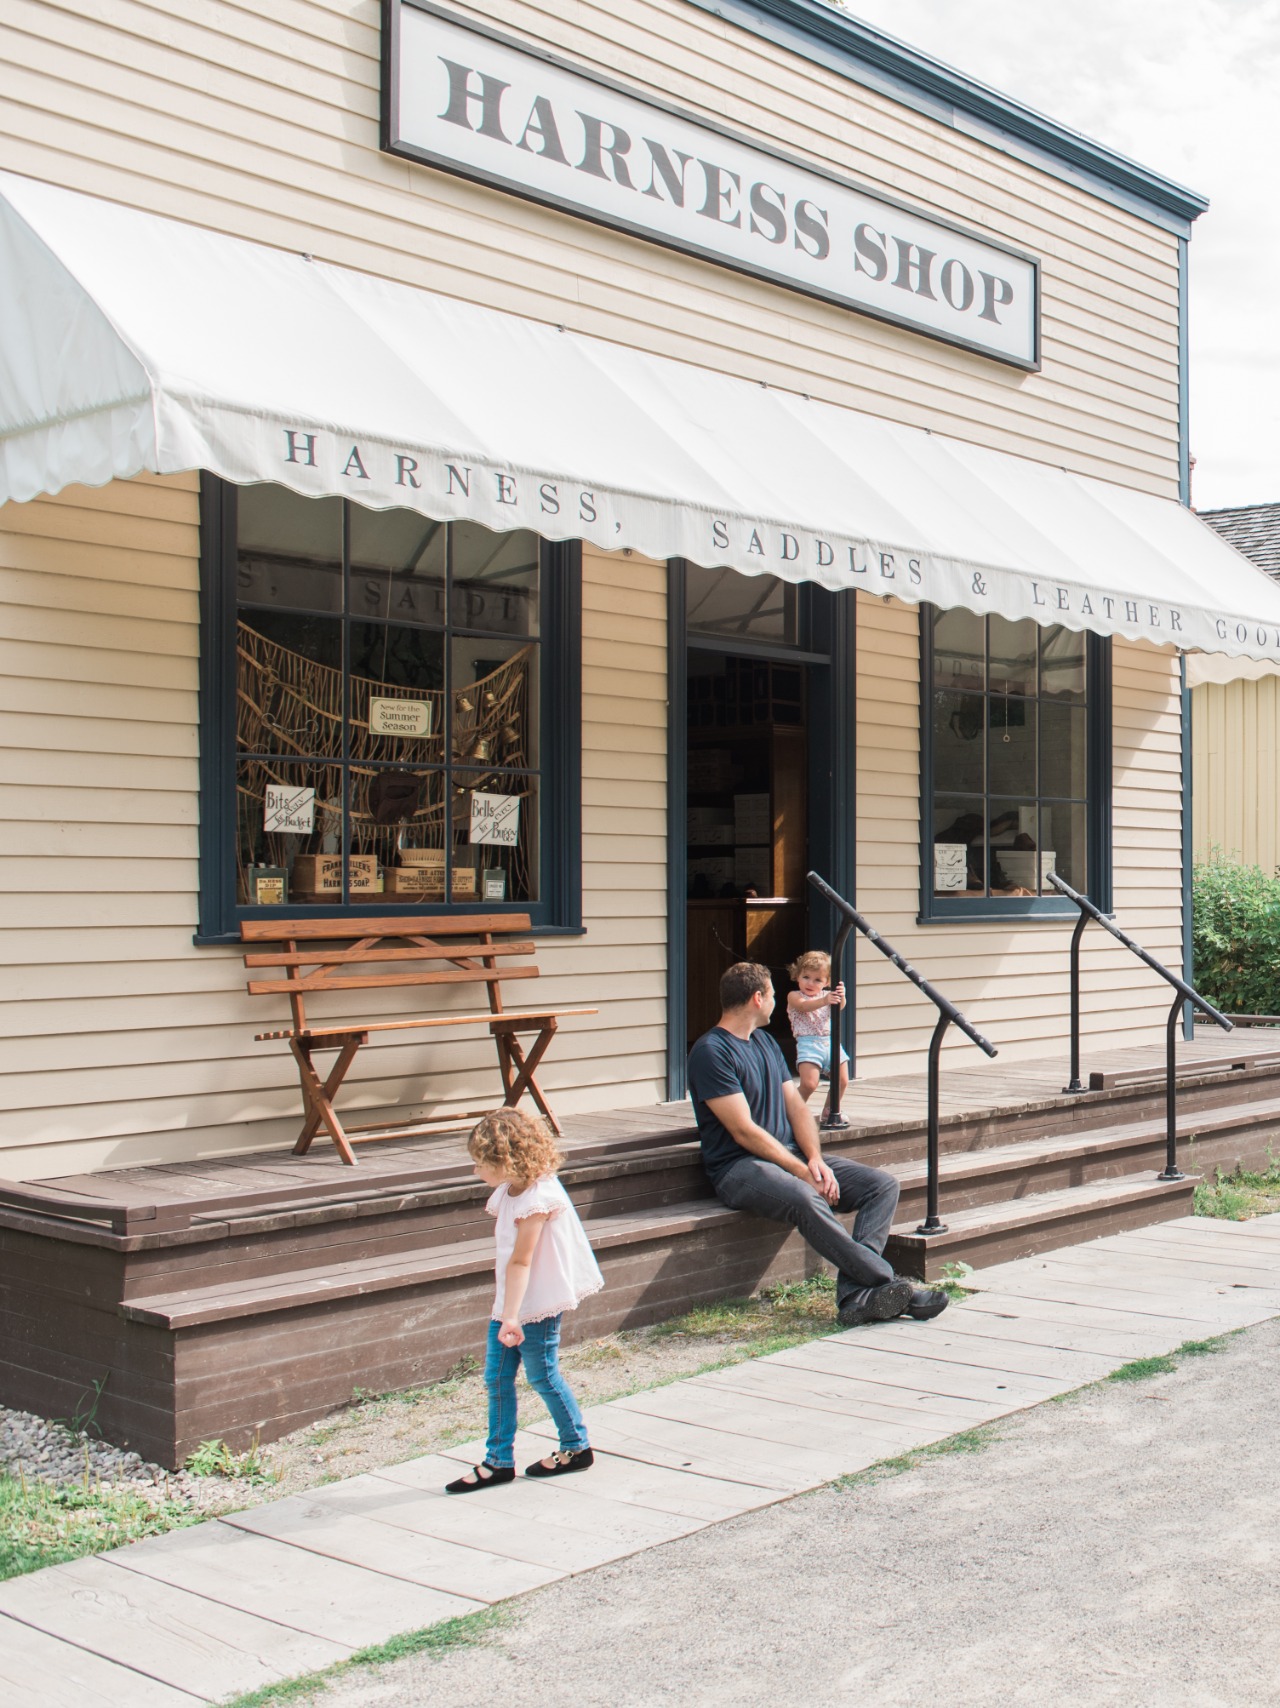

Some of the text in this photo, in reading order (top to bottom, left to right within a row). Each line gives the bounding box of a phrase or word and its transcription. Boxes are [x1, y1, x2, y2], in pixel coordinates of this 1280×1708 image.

[437, 55, 1014, 325] HARNESS SHOP
[283, 429, 622, 533] HARNESS,
[712, 520, 922, 585] SADDLES
[971, 571, 988, 596] &
[1032, 583, 1183, 632] LEATHER
[380, 711, 421, 722] Summer
[382, 721, 417, 731] Season
[266, 791, 291, 810] Bits
[472, 799, 495, 818] Bells
[284, 815, 311, 831] Budget
[491, 821, 516, 842] Buggy
